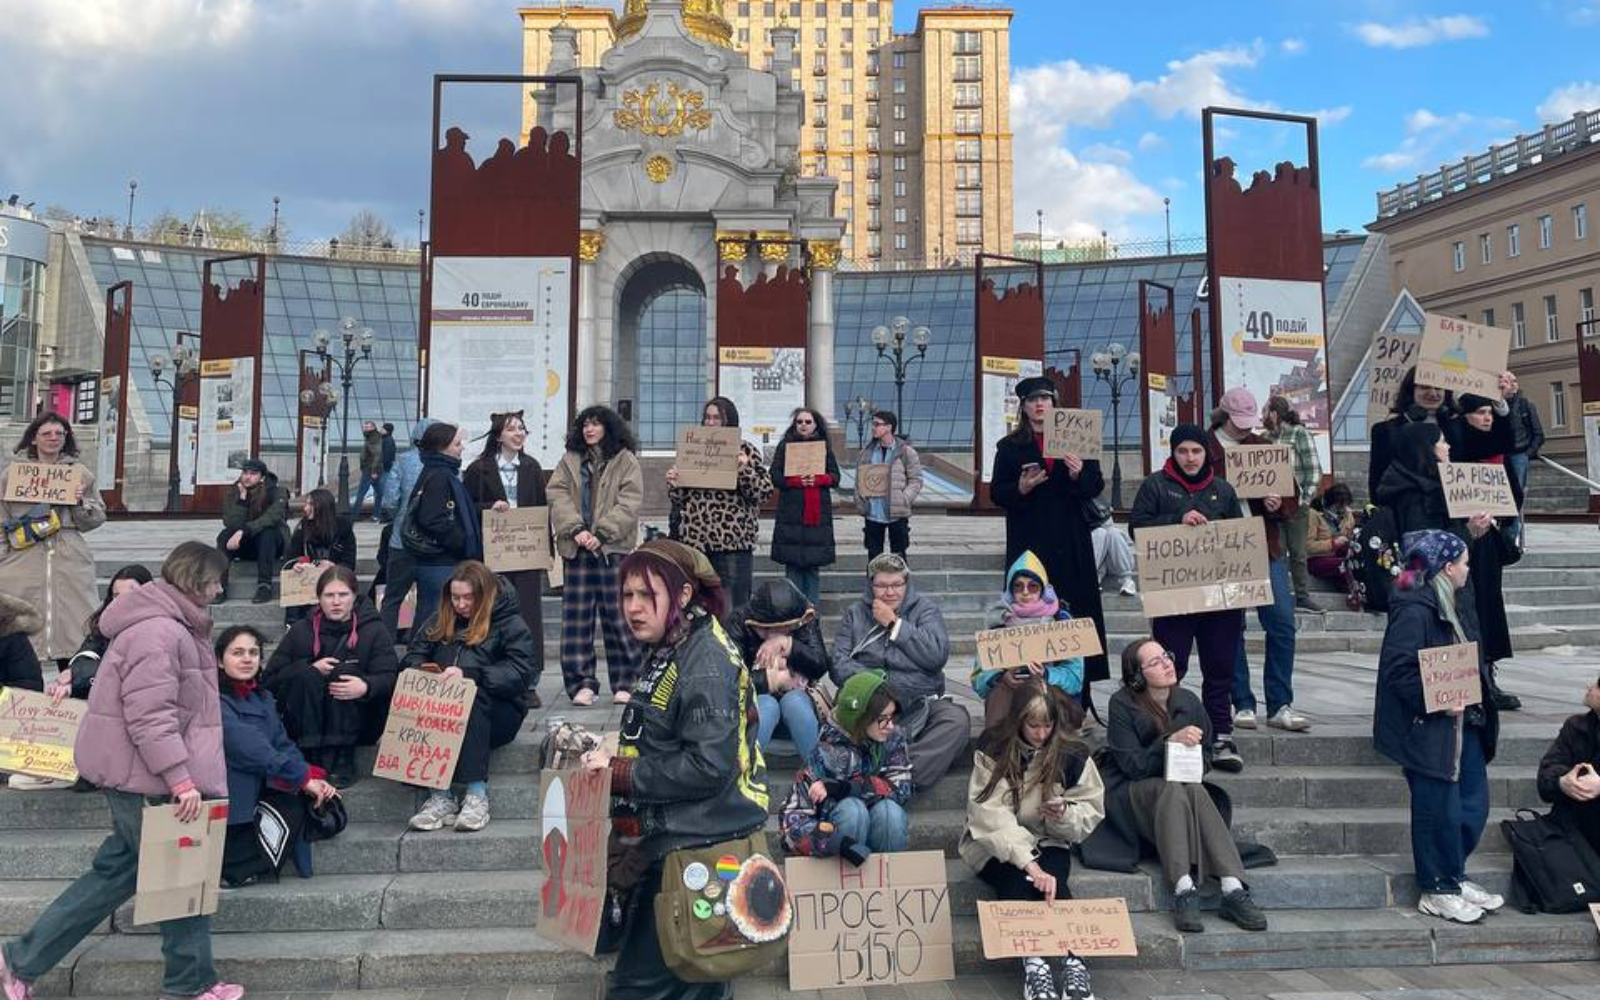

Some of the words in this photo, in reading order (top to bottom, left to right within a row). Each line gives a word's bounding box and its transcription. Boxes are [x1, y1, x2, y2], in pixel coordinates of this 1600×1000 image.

[462, 292, 480, 307] 40
[1246, 310, 1274, 340] 40
[1276, 318, 1307, 333] ПОДІЙ
[1054, 411, 1093, 431] РУКИ
[1226, 451, 1243, 468] МИ
[1248, 446, 1289, 467] ПРОТИ
[17, 466, 39, 477] ПРО
[47, 468, 72, 482] НАС
[1236, 469, 1276, 487] 15150
[1445, 464, 1466, 485] ЗА
[43, 489, 67, 500] НАС
[1146, 531, 1215, 560] НОВИЙ
[1225, 531, 1257, 552] ЦК
[1045, 634, 1081, 657] ASS
[403, 674, 467, 699] НОВИЙ
[392, 693, 464, 717] ЦИВІЛЬНИЙ
[416, 715, 465, 734] КОДЕКС
[398, 726, 430, 745] КРОК
[794, 888, 948, 931] ПРОЄКТУ
[1013, 939, 1042, 951] НІ
[1057, 938, 1121, 951] #15150
[832, 929, 923, 985] 15150
